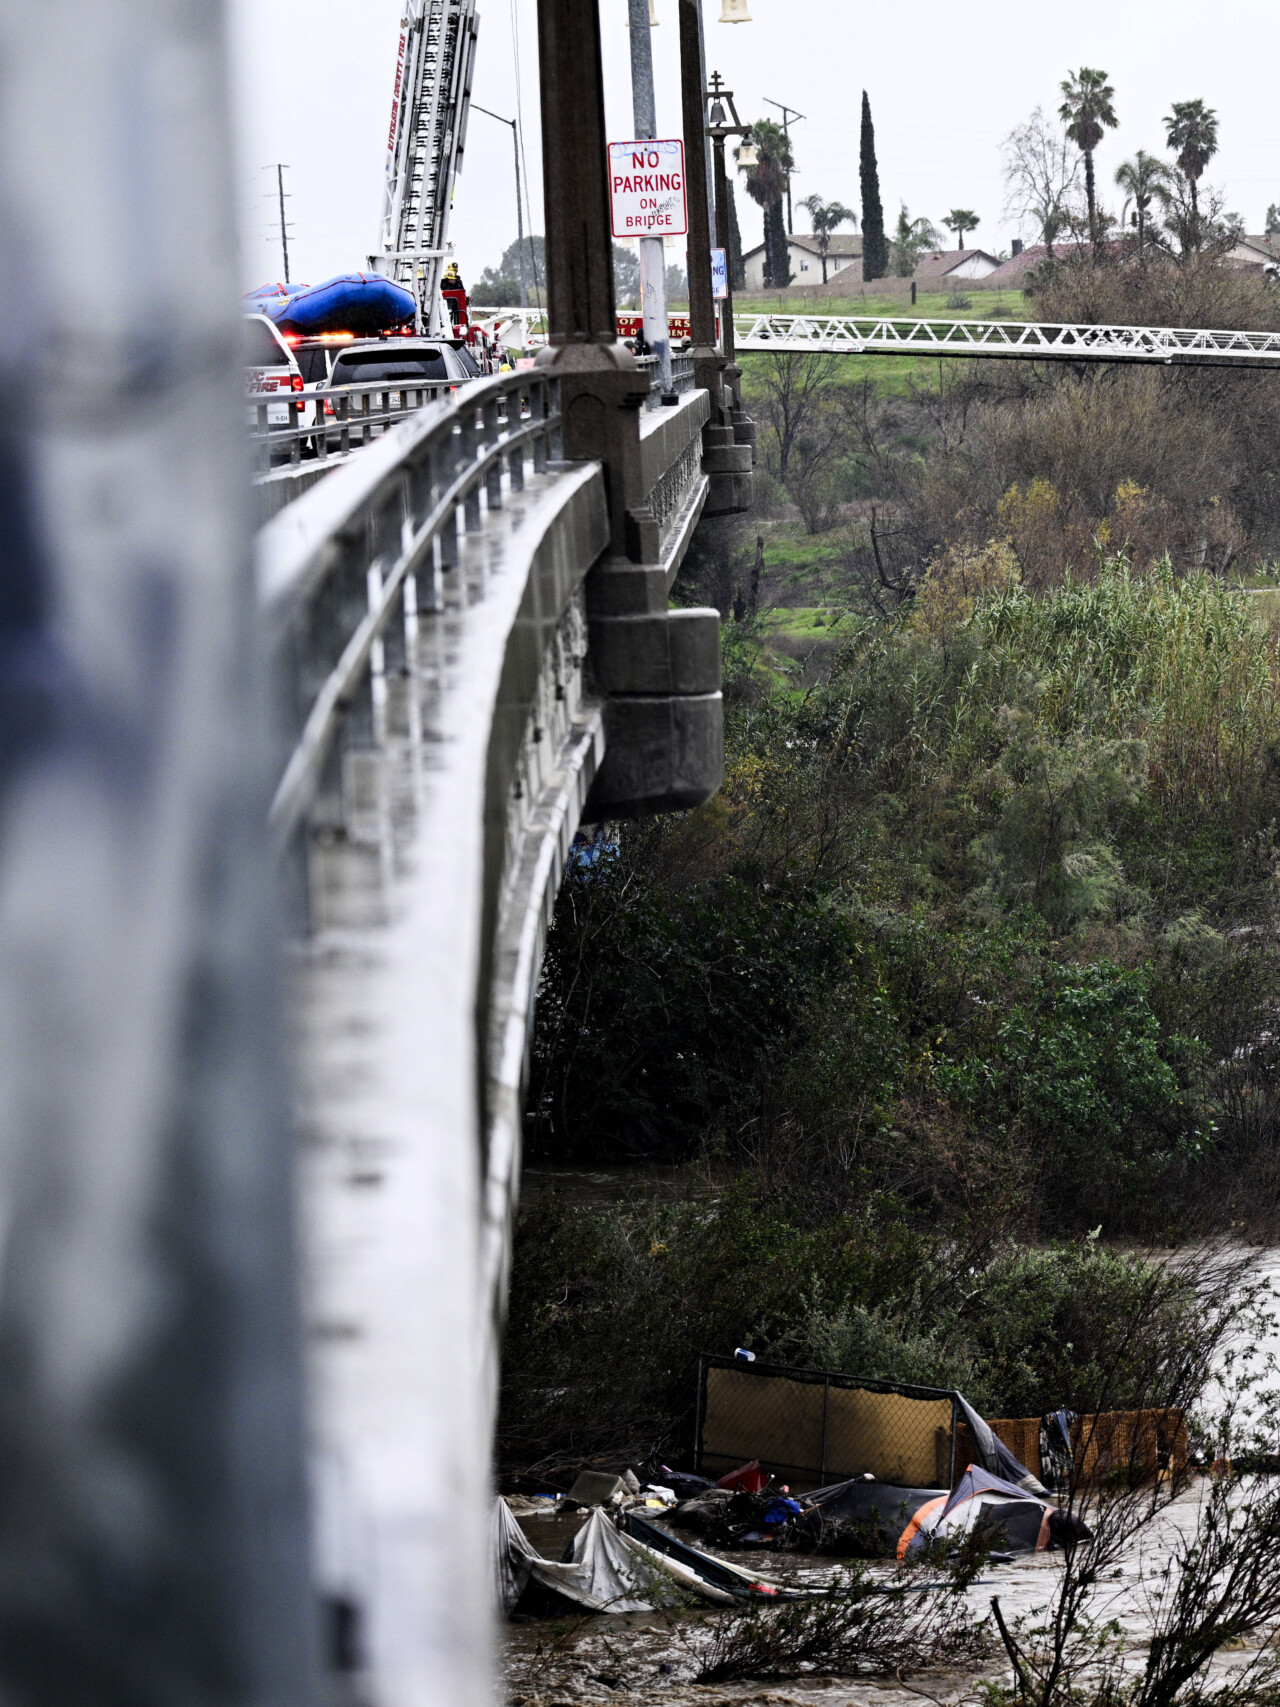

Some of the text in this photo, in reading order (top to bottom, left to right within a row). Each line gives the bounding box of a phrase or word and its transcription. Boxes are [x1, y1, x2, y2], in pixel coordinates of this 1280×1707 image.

[387, 33, 406, 153] RIVERSIDE COUNTY FIRE
[632, 151, 659, 169] NO
[613, 173, 681, 193] PARKING
[640, 198, 657, 209] ON
[626, 214, 672, 227] BRIDGE
[248, 382, 279, 393] FIRE
